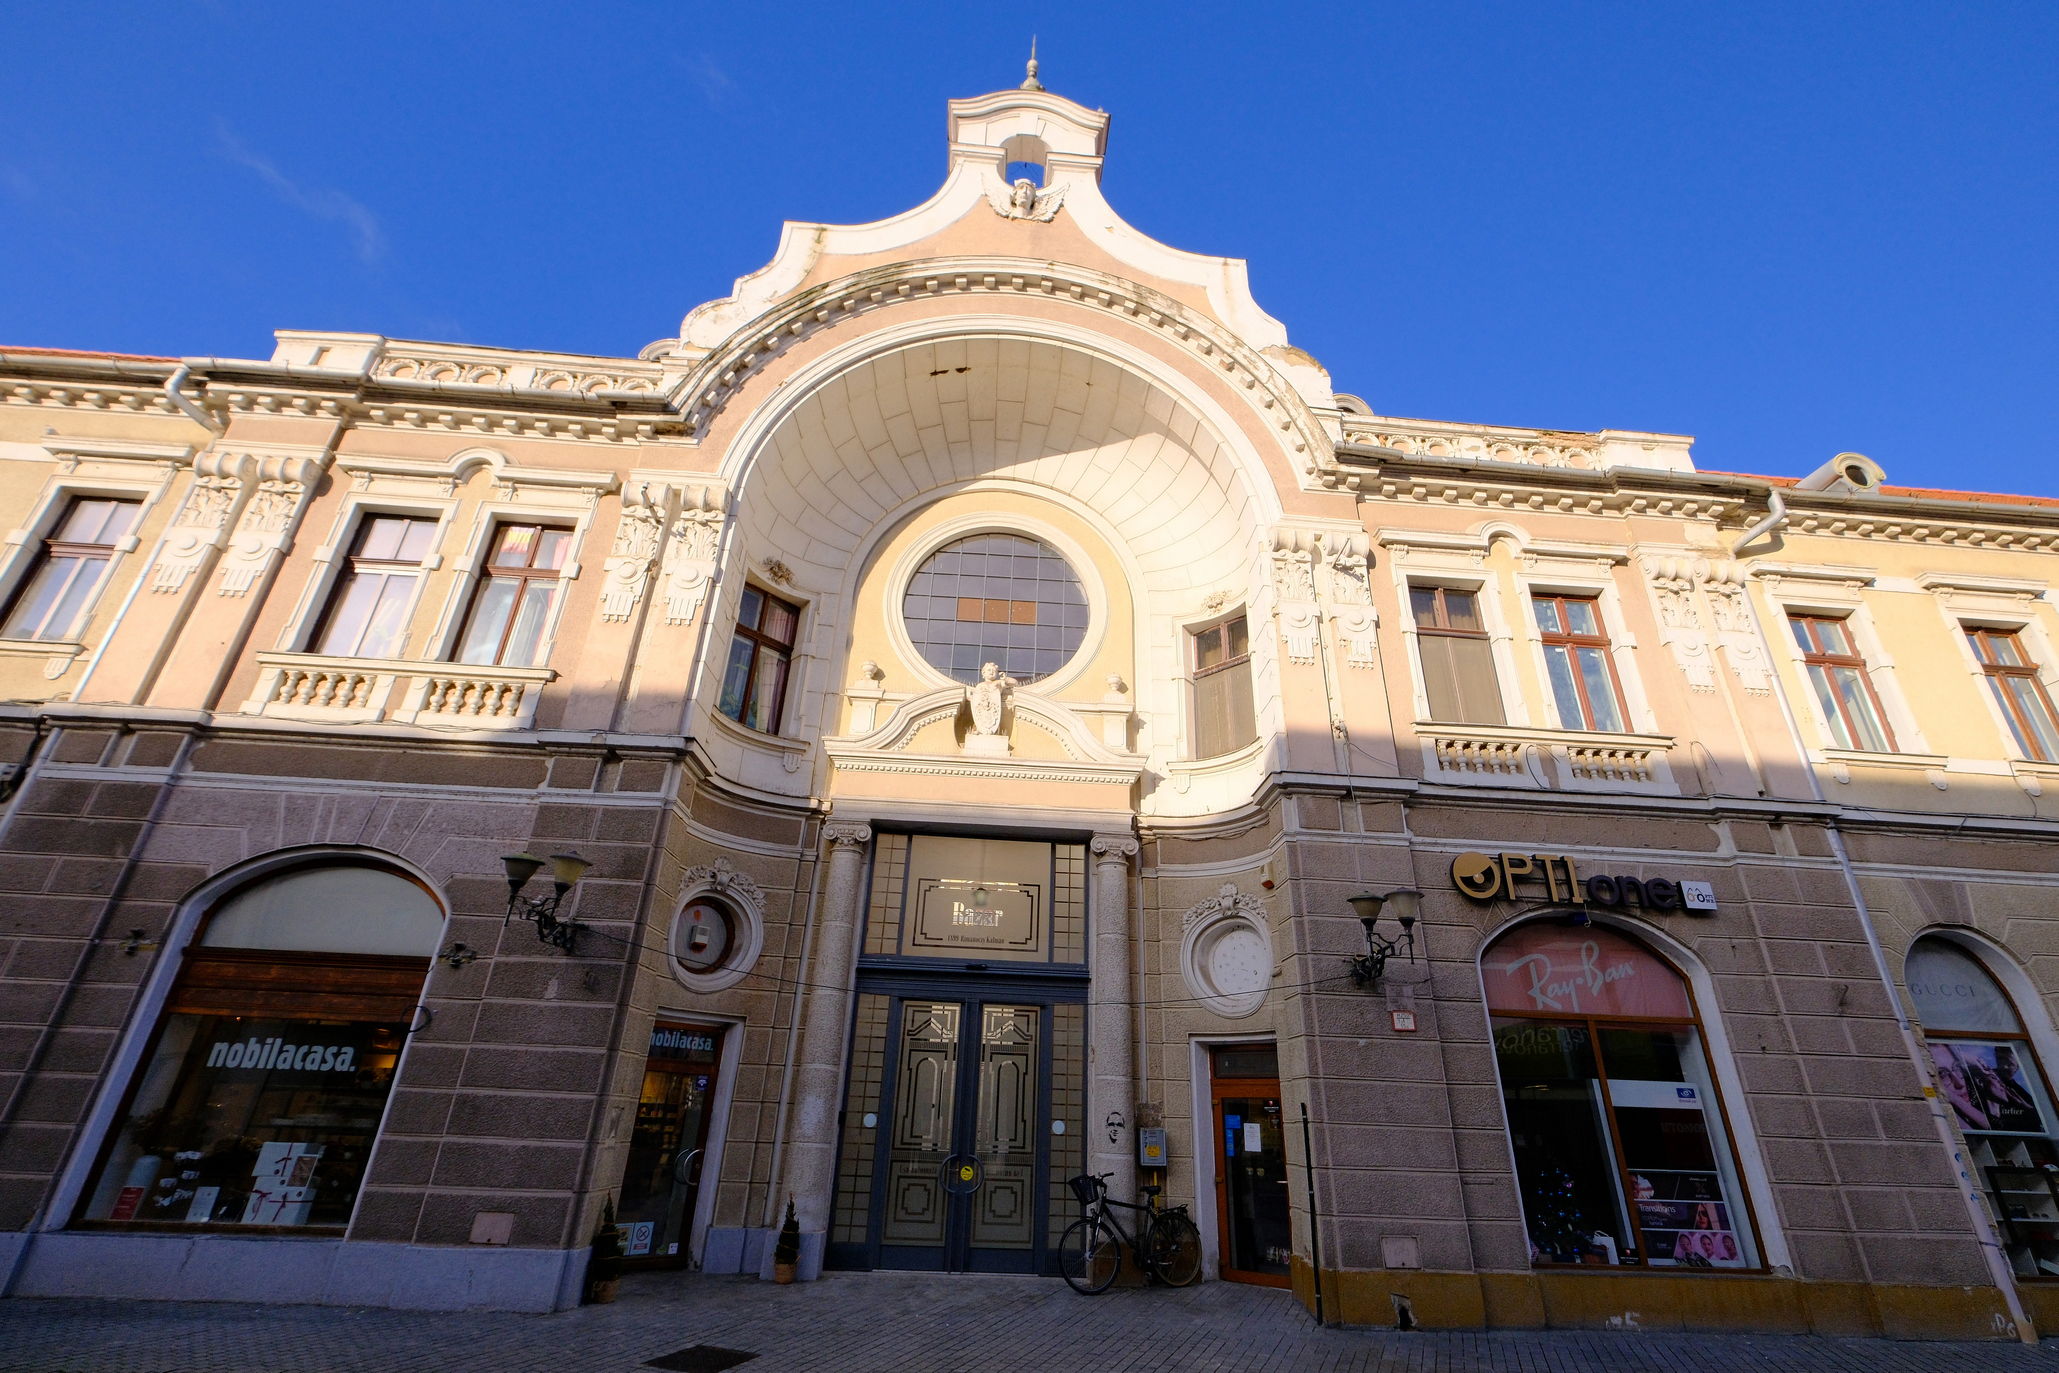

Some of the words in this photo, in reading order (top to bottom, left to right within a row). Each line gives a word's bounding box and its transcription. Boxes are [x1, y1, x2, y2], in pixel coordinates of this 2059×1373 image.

[1450, 851, 1584, 904] OPTI
[1586, 874, 1678, 910] one
[952, 901, 1004, 926] Bazar
[1506, 940, 1634, 1013] Ray-Ban
[1910, 983, 1977, 998] GUCCI
[206, 1037, 357, 1072] nobilacasa.
